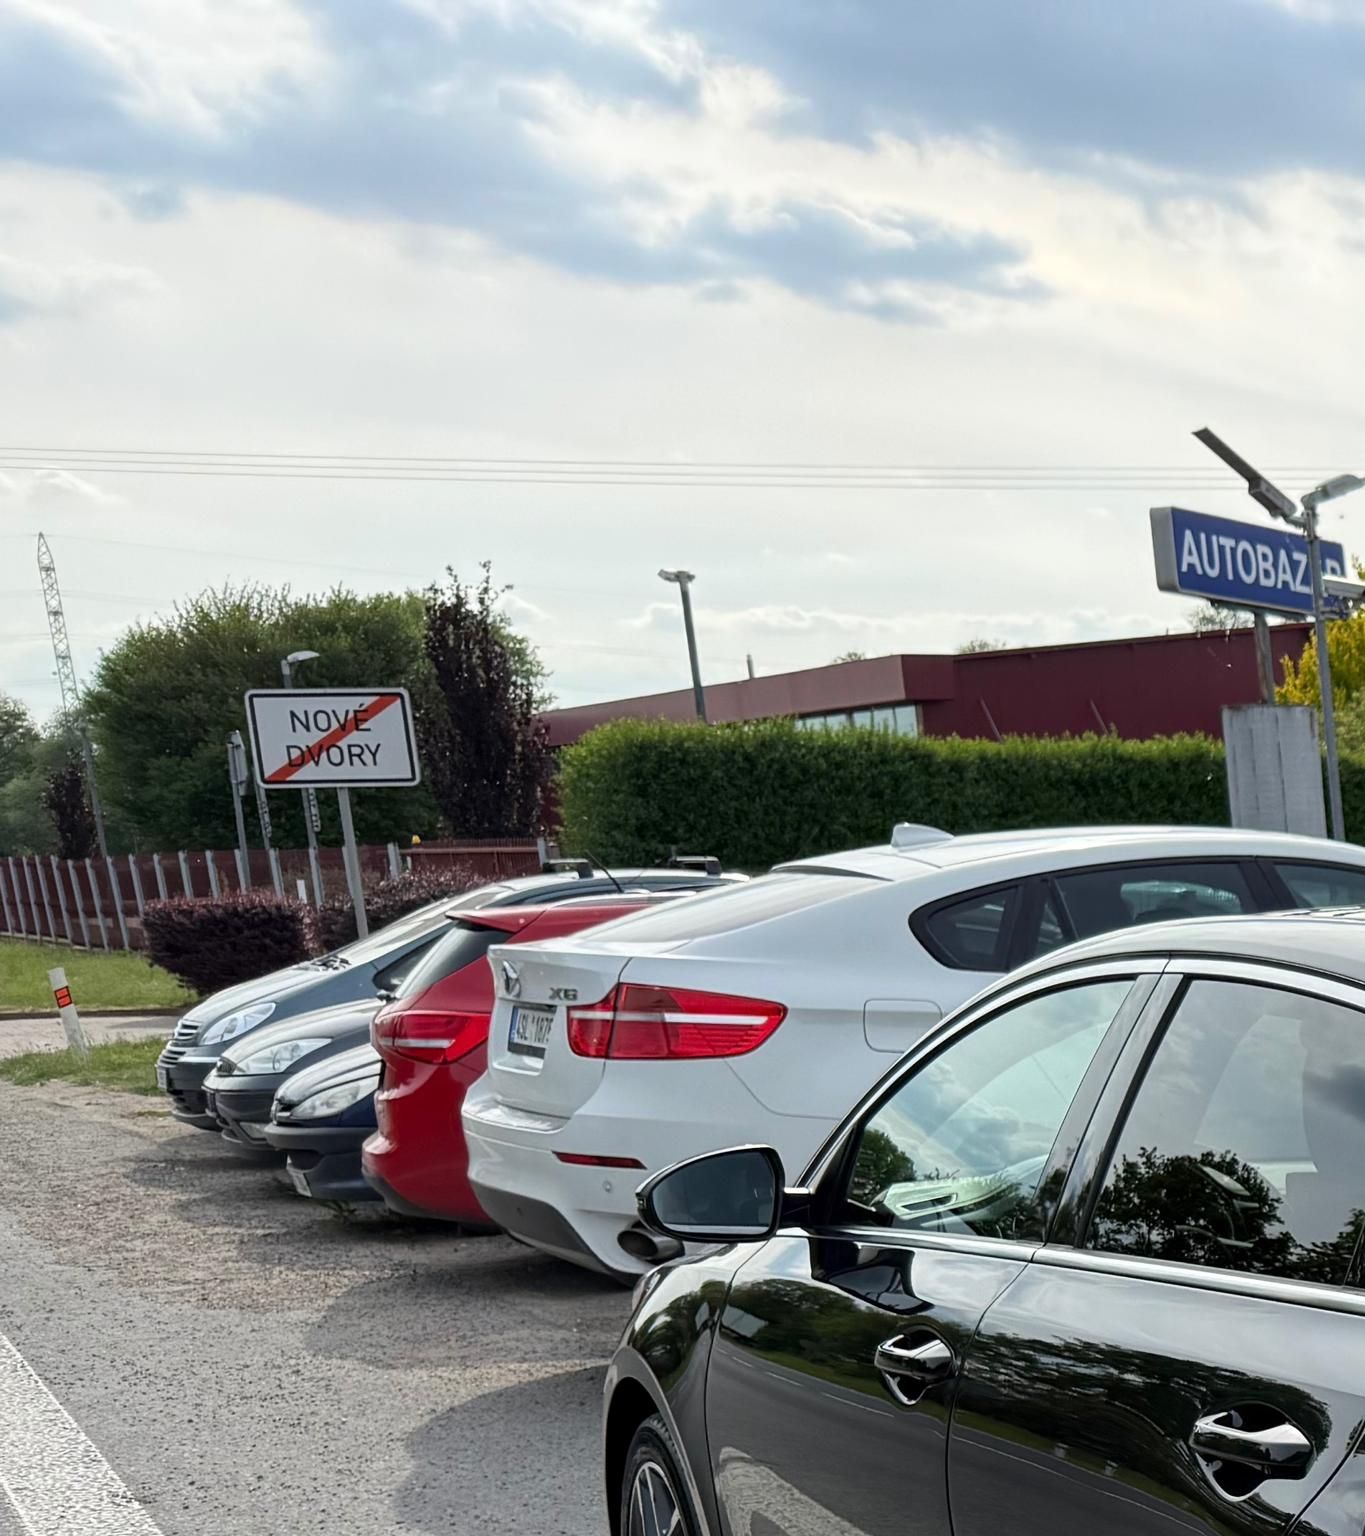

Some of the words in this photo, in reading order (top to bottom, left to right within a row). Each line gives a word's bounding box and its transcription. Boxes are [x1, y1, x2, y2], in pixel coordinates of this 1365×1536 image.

[1181, 529, 1342, 598] AUTOBAZ
[289, 703, 372, 734] NOVÉ
[286, 743, 382, 768] DVORY
[548, 987, 578, 1001] X6
